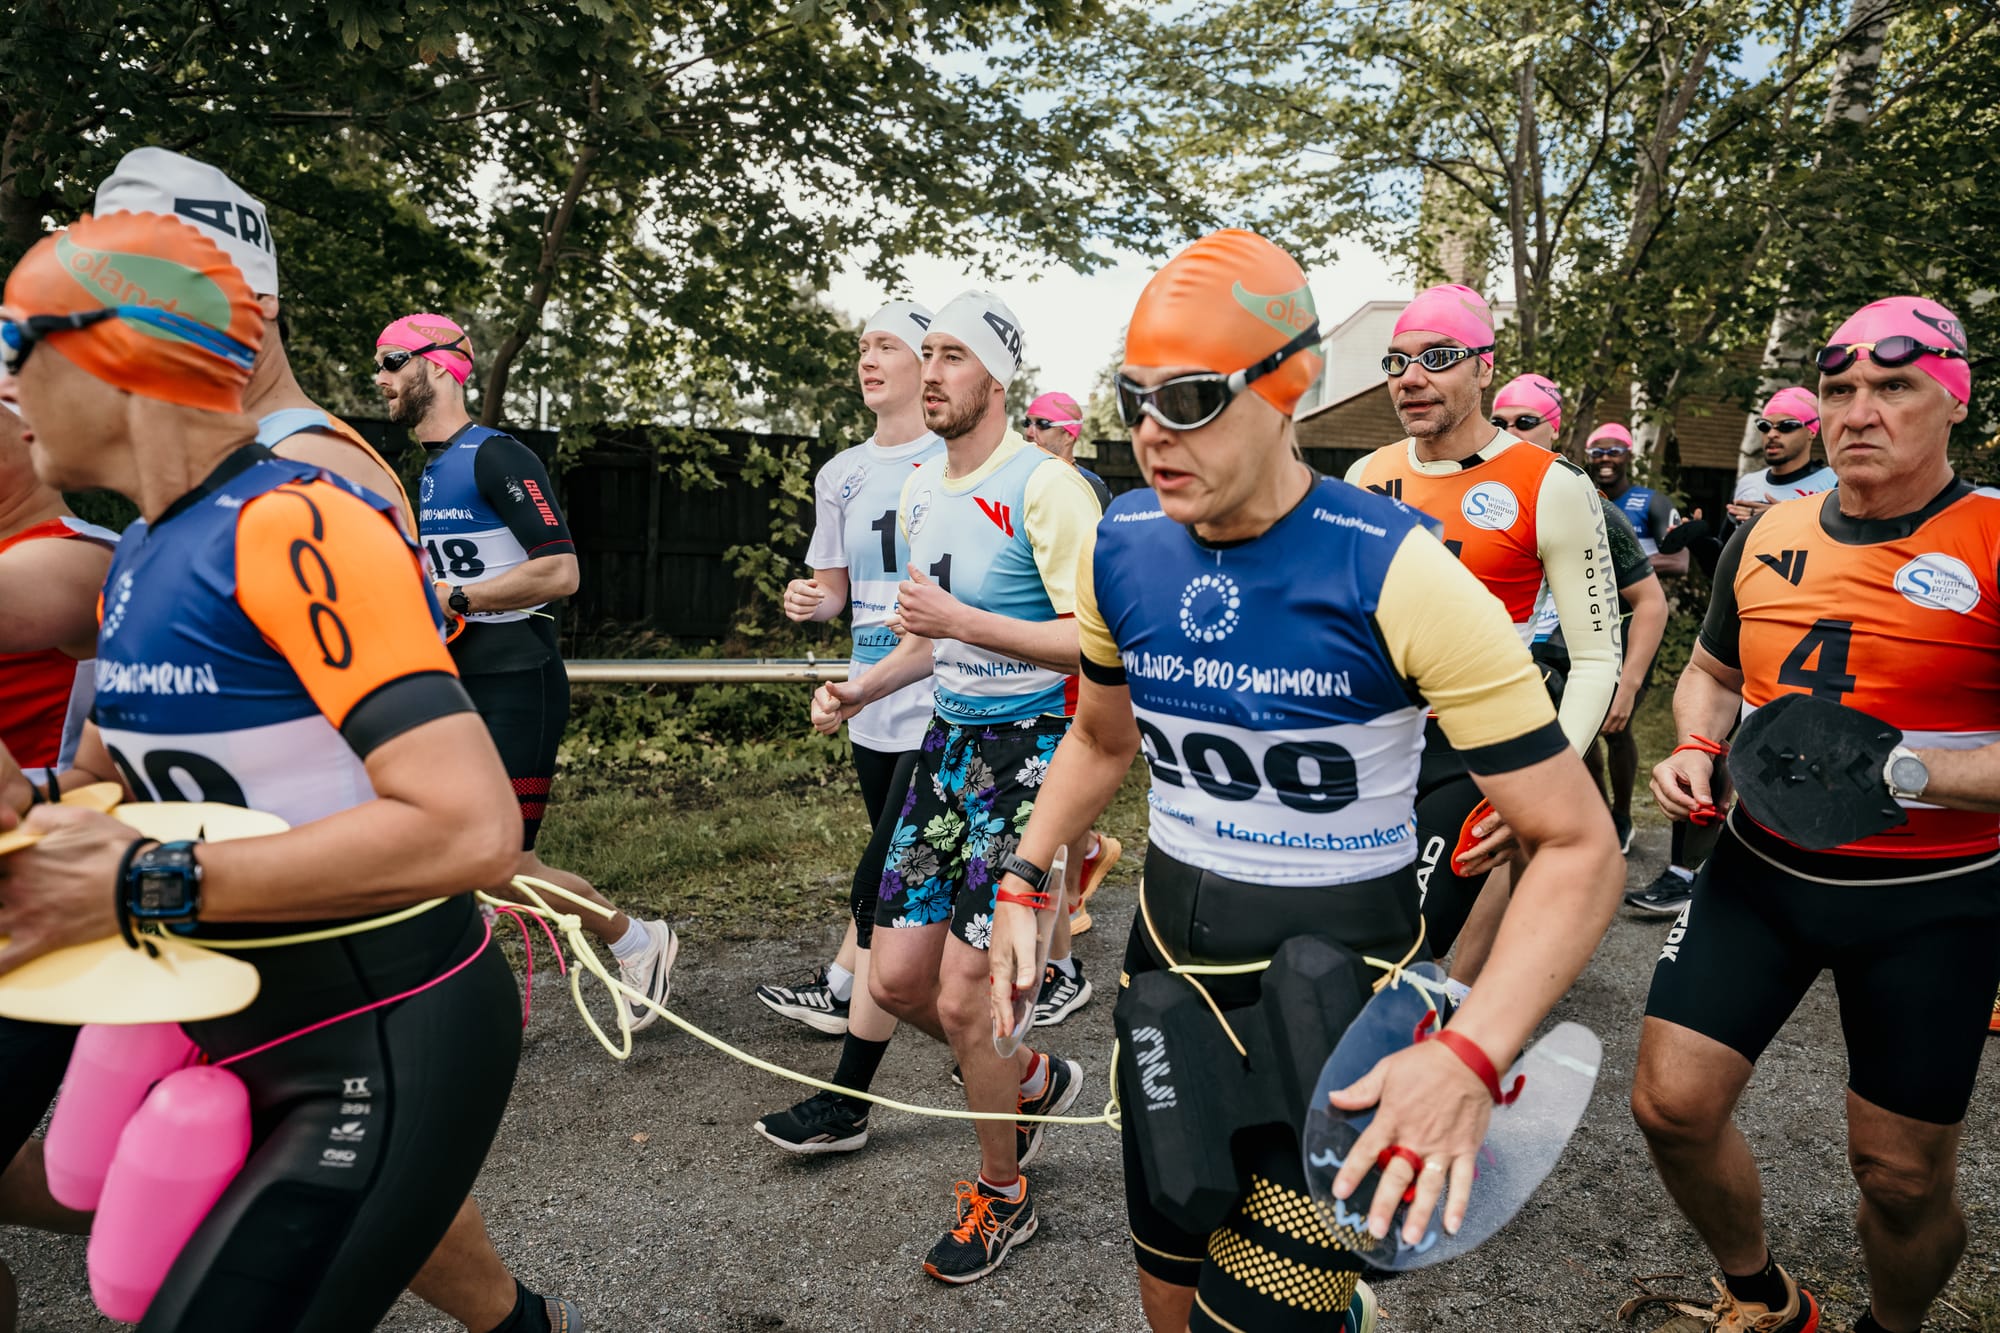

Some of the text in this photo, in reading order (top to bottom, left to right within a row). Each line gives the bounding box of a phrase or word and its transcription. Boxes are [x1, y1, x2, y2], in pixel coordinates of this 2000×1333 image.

[872, 510, 897, 573] 1
[1584, 549, 1603, 632] ROUGH
[1236, 664, 1352, 697] SWIMRUN
[1777, 618, 1857, 704] 4
